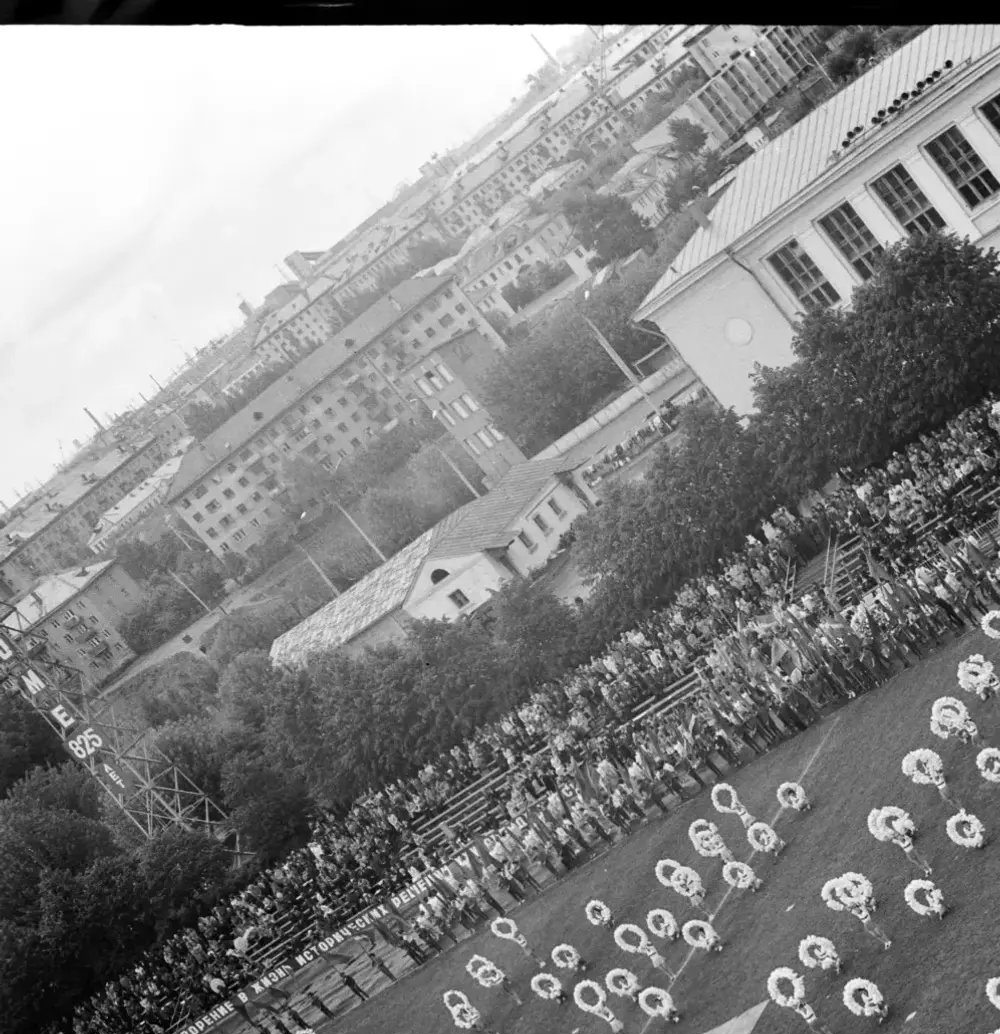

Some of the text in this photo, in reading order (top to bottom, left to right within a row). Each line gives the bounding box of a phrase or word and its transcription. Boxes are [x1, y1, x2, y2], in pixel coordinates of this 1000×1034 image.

[68, 727, 103, 759] 825
[103, 763, 125, 789] ЛЕТ
[237, 991, 249, 1003] В
